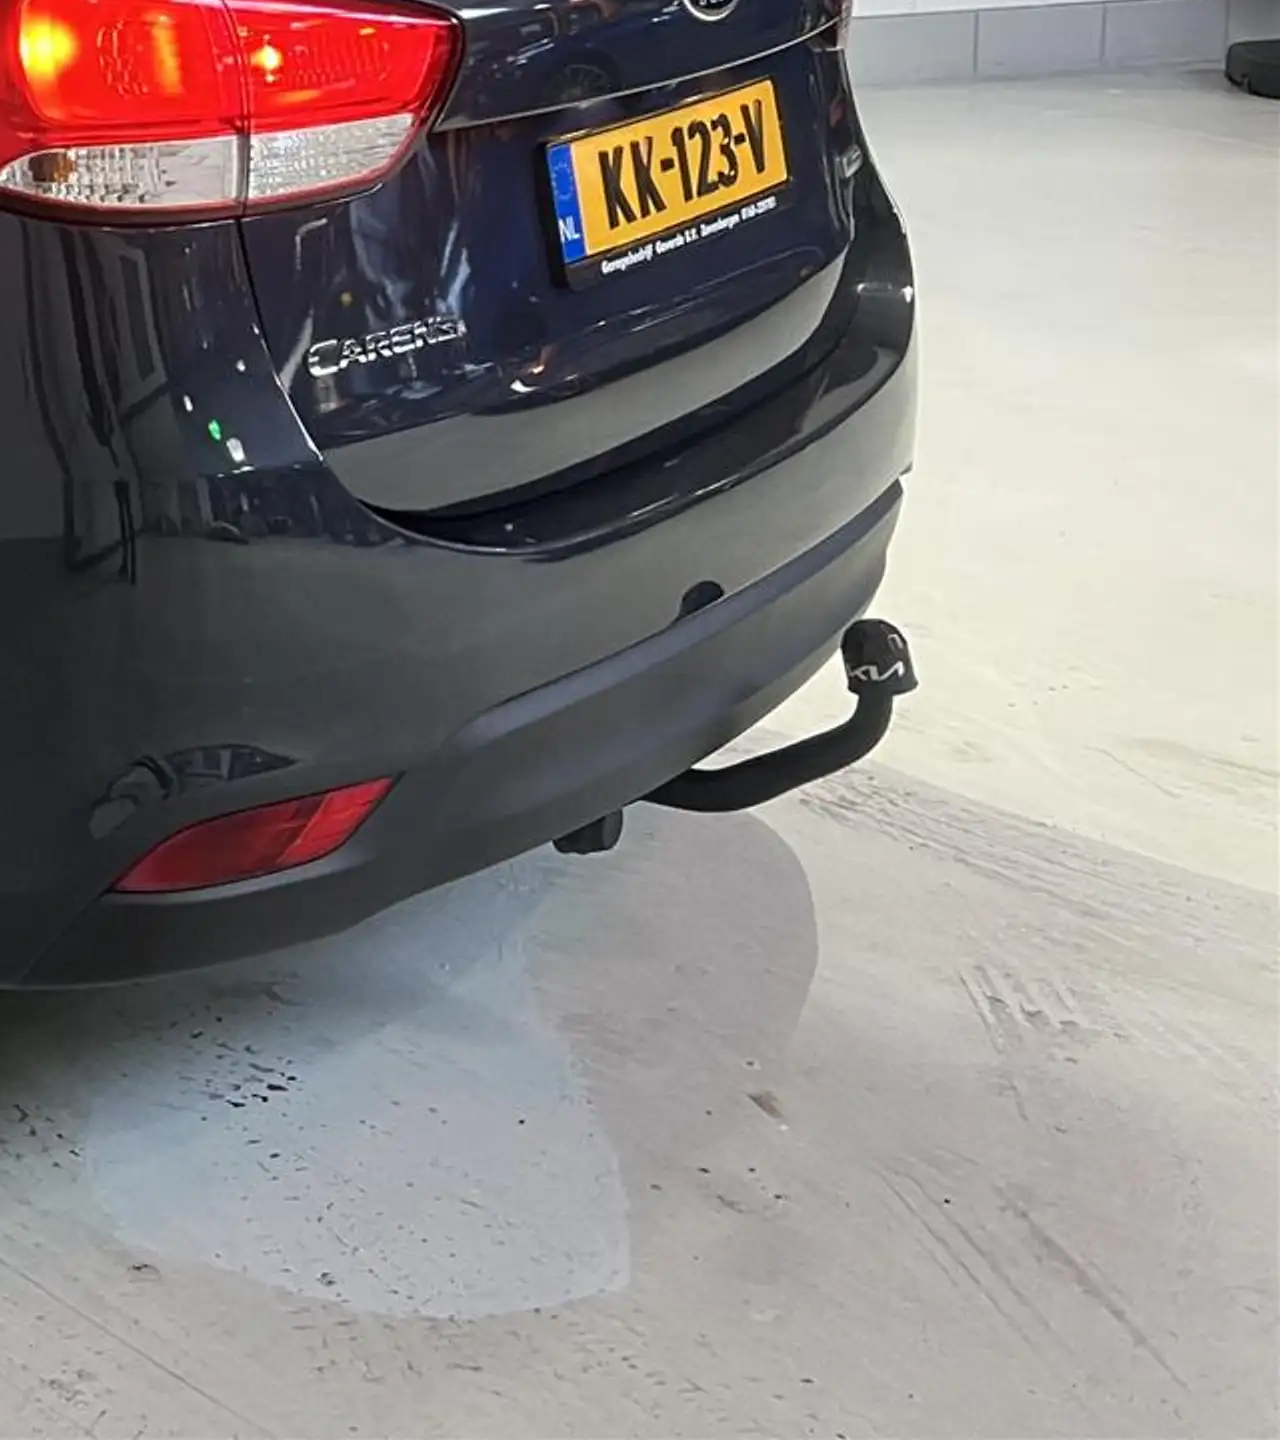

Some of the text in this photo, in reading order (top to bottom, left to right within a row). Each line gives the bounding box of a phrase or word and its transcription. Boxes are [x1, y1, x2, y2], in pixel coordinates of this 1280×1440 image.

[598, 98, 766, 230] KK-123-V
[558, 216, 581, 242] NL
[308, 316, 467, 377] CARENS
